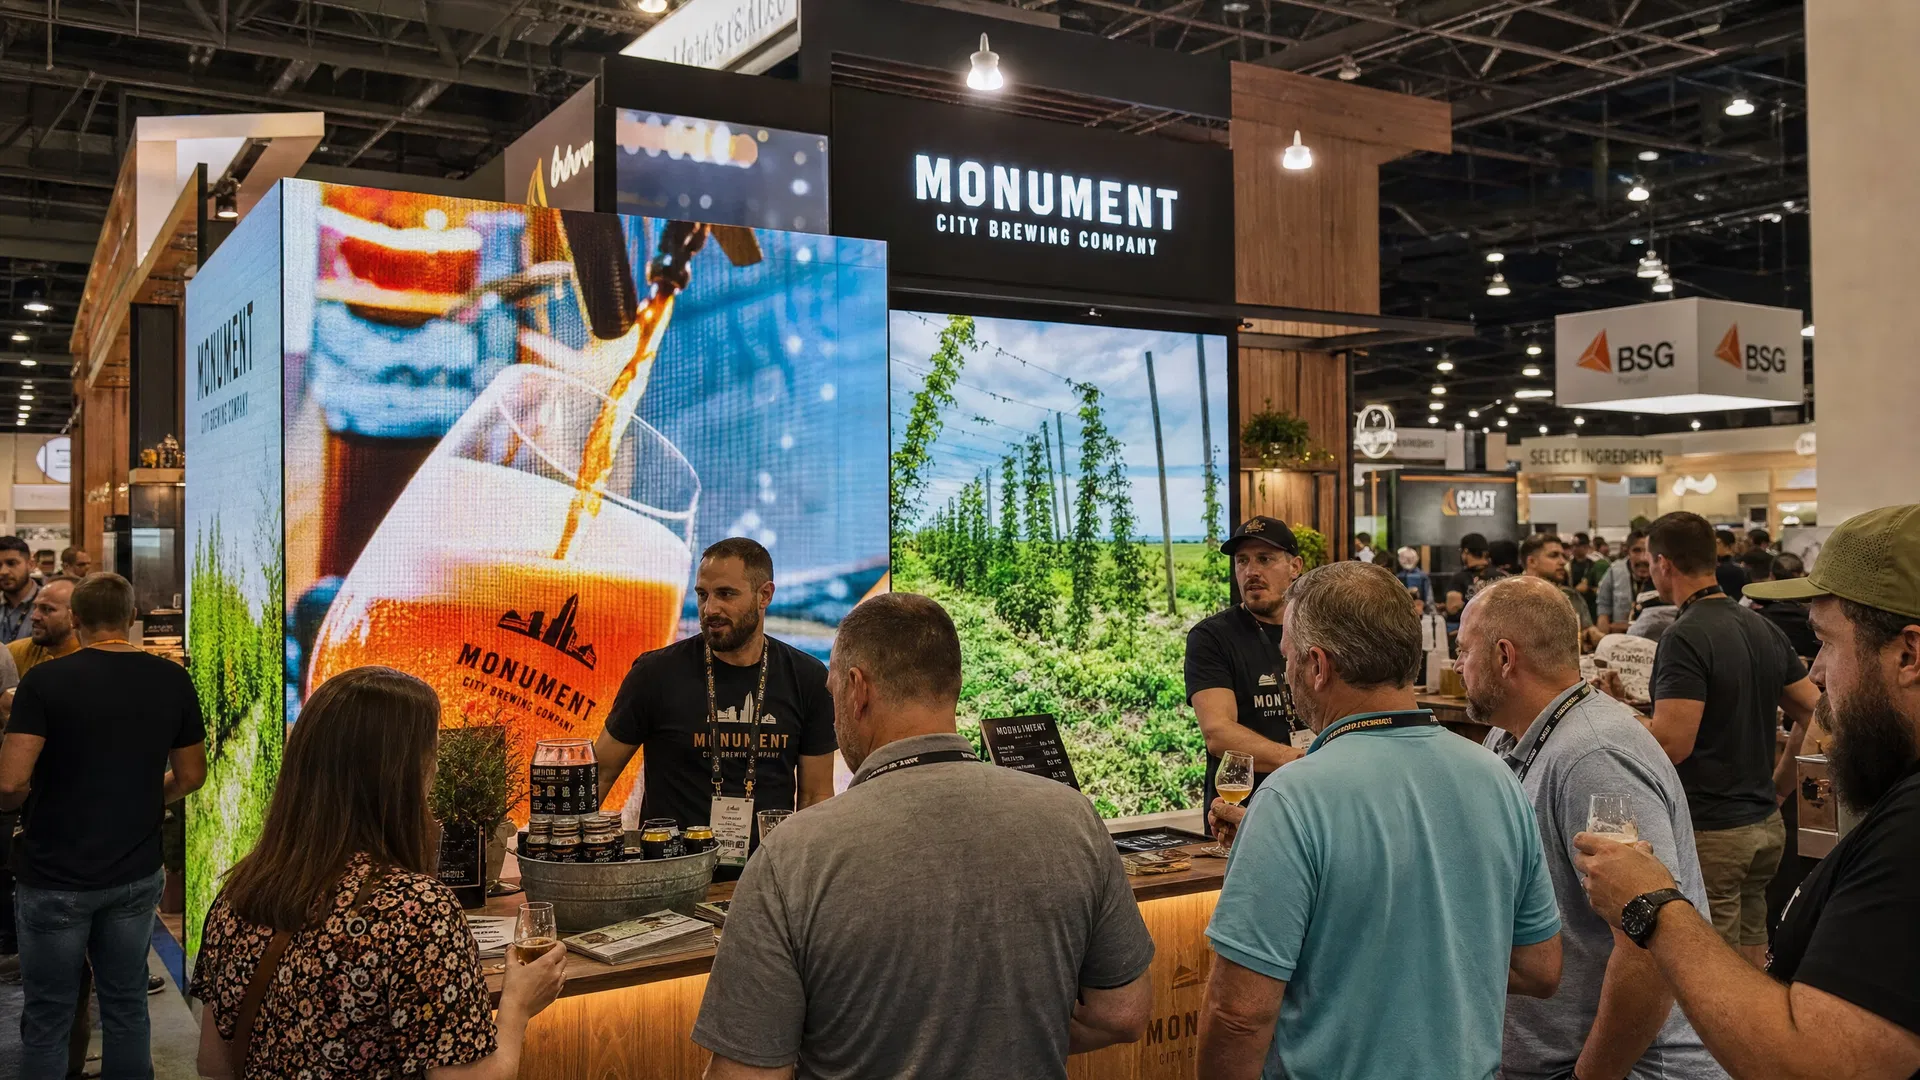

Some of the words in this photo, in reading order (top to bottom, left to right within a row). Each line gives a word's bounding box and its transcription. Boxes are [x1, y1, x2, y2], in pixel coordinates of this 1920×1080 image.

[915, 154, 1178, 231] MONUMENT
[936, 213, 979, 236] CITY
[989, 219, 1070, 247] BREWING
[1079, 230, 1157, 256] COMPANY
[197, 300, 253, 401] MONUMENT
[1617, 341, 1675, 373] BSG
[1746, 344, 1786, 373] BSG
[1530, 448, 1578, 465] SELECT
[1581, 448, 1664, 465] INGREDIENTS
[1456, 489, 1497, 509] CRAFT
[456, 643, 597, 721] MONUMENT
[462, 676, 488, 693] CITY
[489, 685, 534, 712] BREWING
[535, 706, 575, 734] COMPANY
[693, 732, 789, 748] MNUMENT
[1160, 1049, 1182, 1065] CITY
